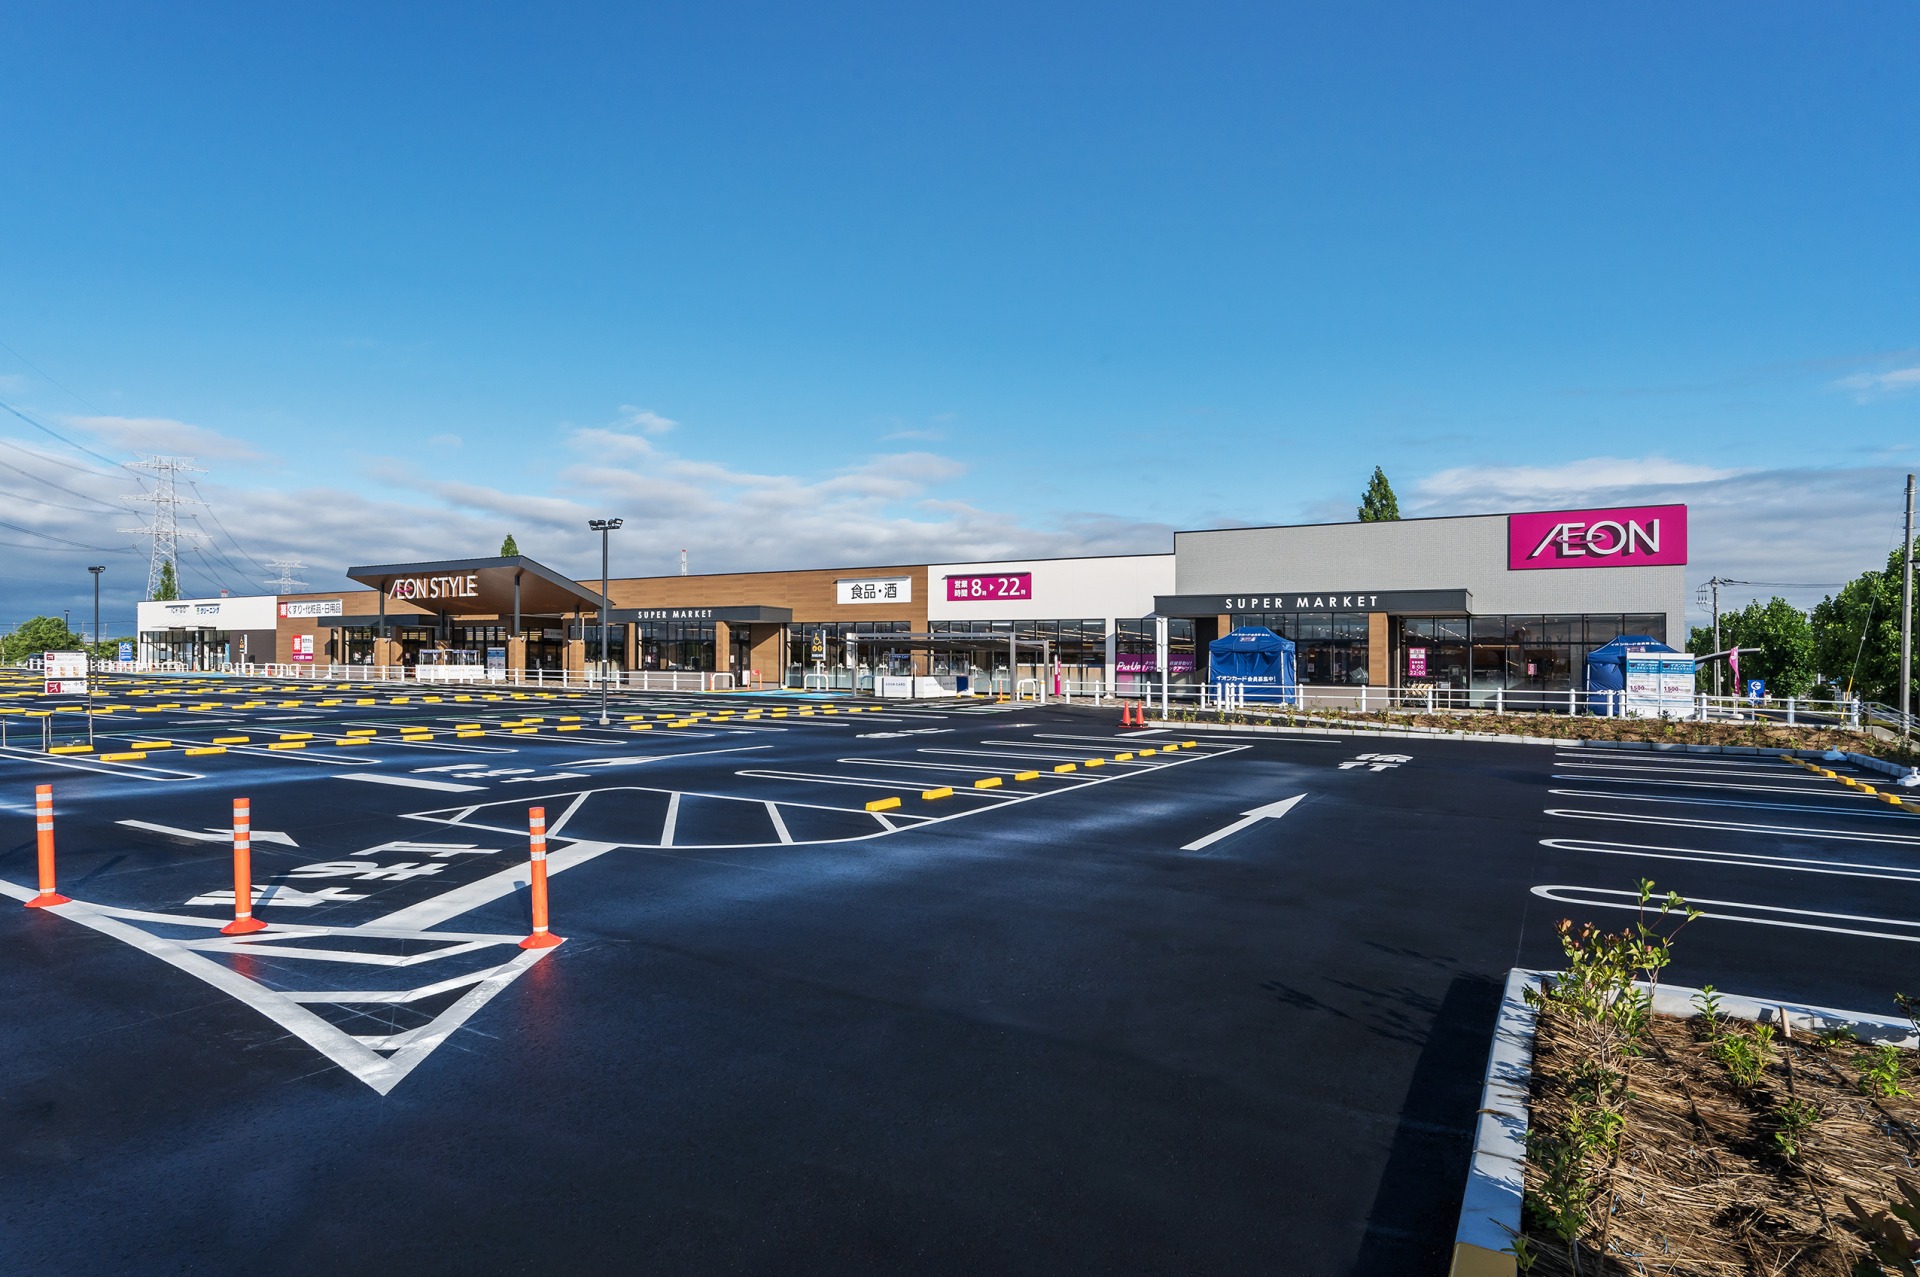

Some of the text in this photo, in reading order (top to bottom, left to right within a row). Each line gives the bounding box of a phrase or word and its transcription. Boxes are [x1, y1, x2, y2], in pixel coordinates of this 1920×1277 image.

[430, 575, 477, 598] STYLE
[851, 583, 897, 599] 食品・酒
[1225, 596, 1377, 609] SUPER MARKET
[280, 603, 287, 617] 薬
[638, 610, 712, 619] SUPER MARKET
